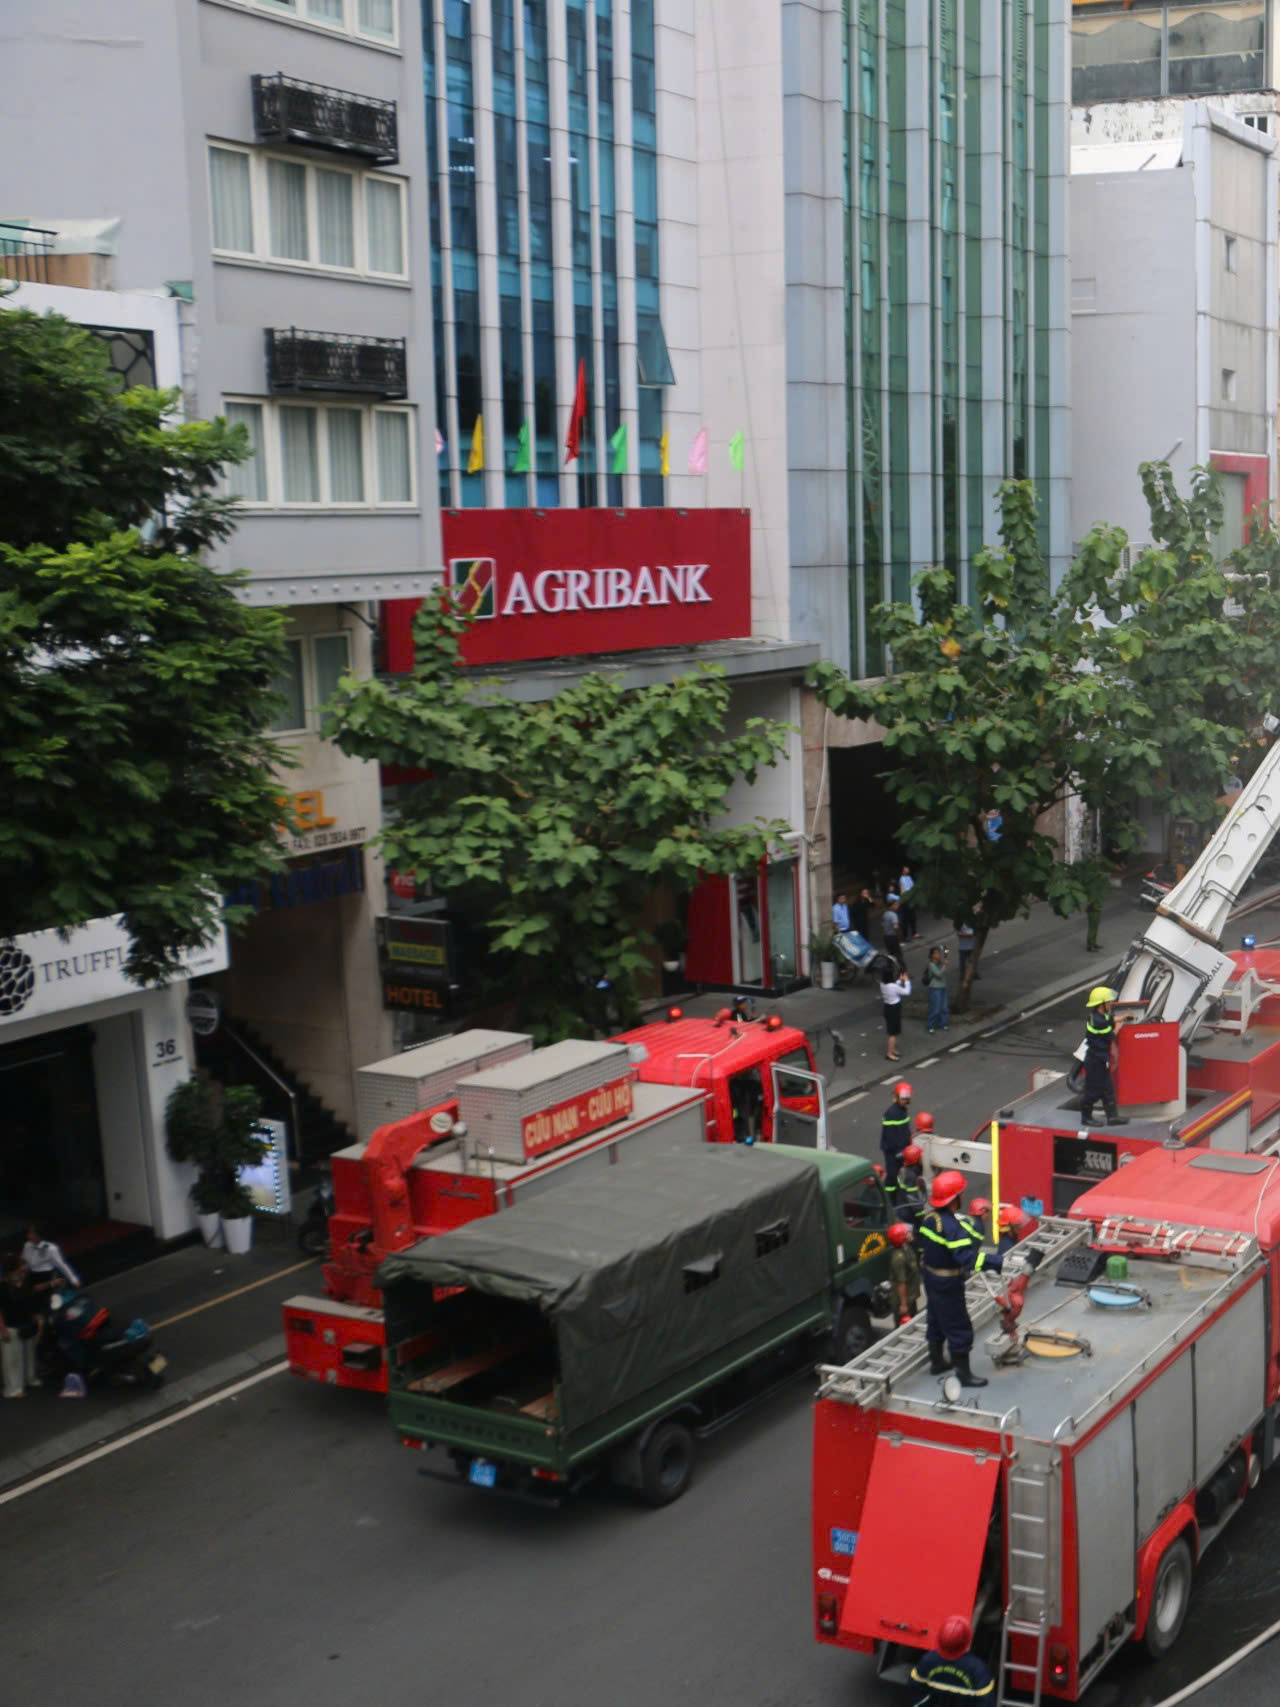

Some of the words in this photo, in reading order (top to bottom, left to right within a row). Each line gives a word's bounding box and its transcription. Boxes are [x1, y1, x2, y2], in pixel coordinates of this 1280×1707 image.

[501, 564, 713, 615] AGRIBANK
[39, 946, 131, 984] TRUFFL
[387, 984, 443, 1009] HOTEL
[156, 1039, 176, 1058] 36
